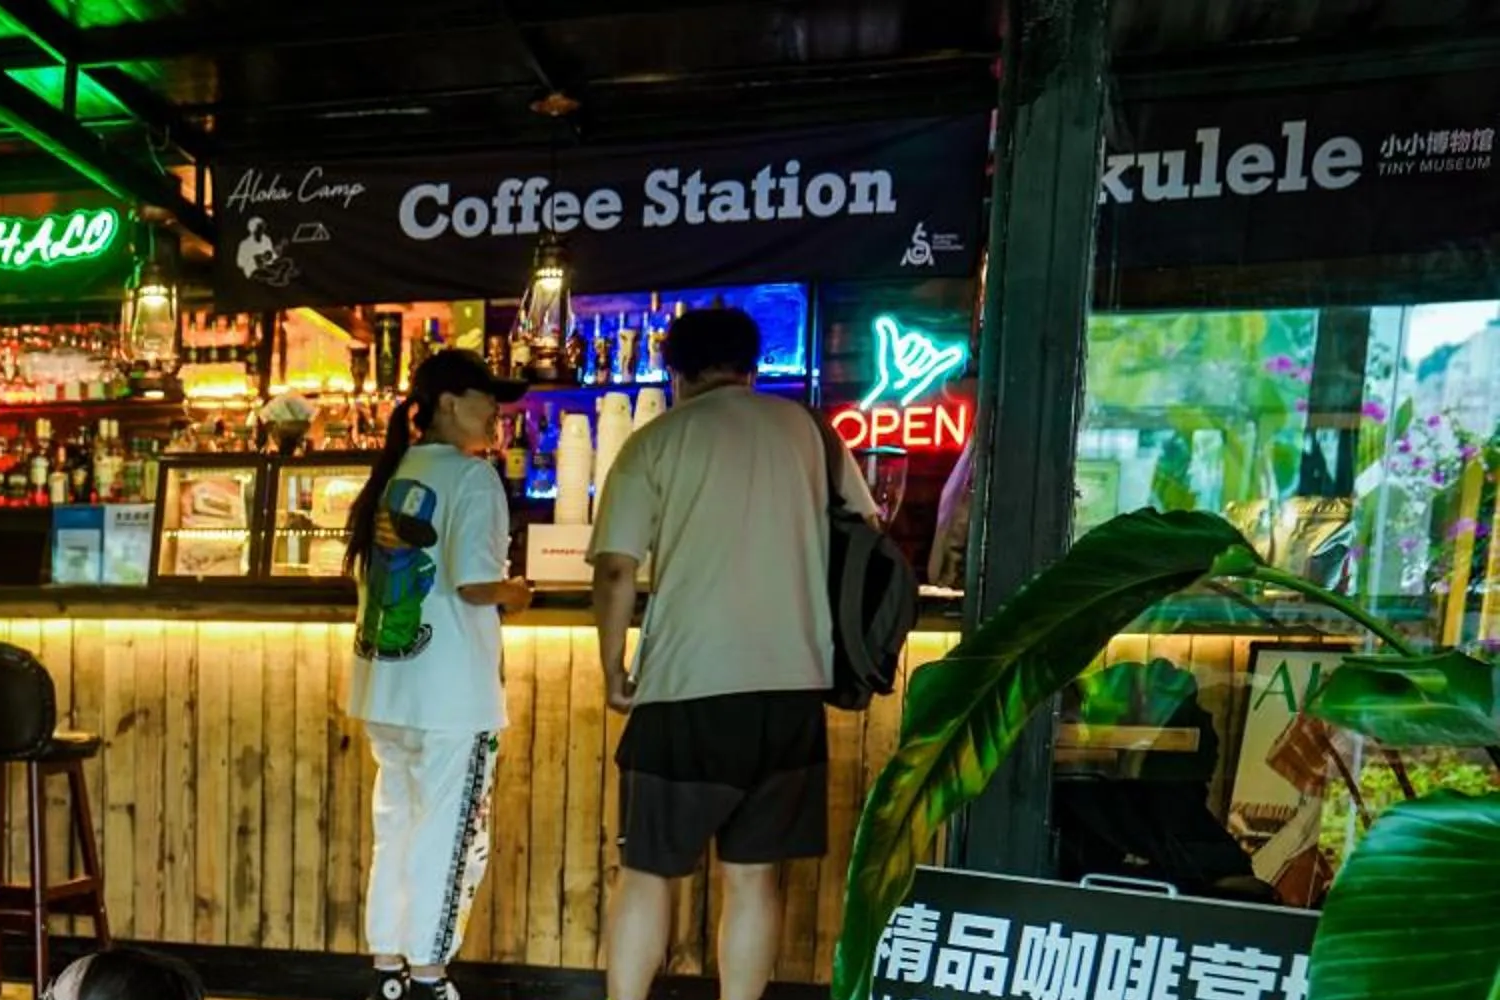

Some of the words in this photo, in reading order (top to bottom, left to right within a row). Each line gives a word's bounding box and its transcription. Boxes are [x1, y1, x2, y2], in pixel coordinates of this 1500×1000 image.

[1379, 127, 1495, 159] 小小博物馆
[1378, 160, 1416, 177] TINY
[1418, 155, 1492, 173] MUSEUM
[226, 168, 293, 213] Aloha
[297, 166, 366, 208] Camp
[399, 177, 623, 240] Coffee
[642, 159, 897, 228] Station
[831, 405, 966, 449] OPEN
